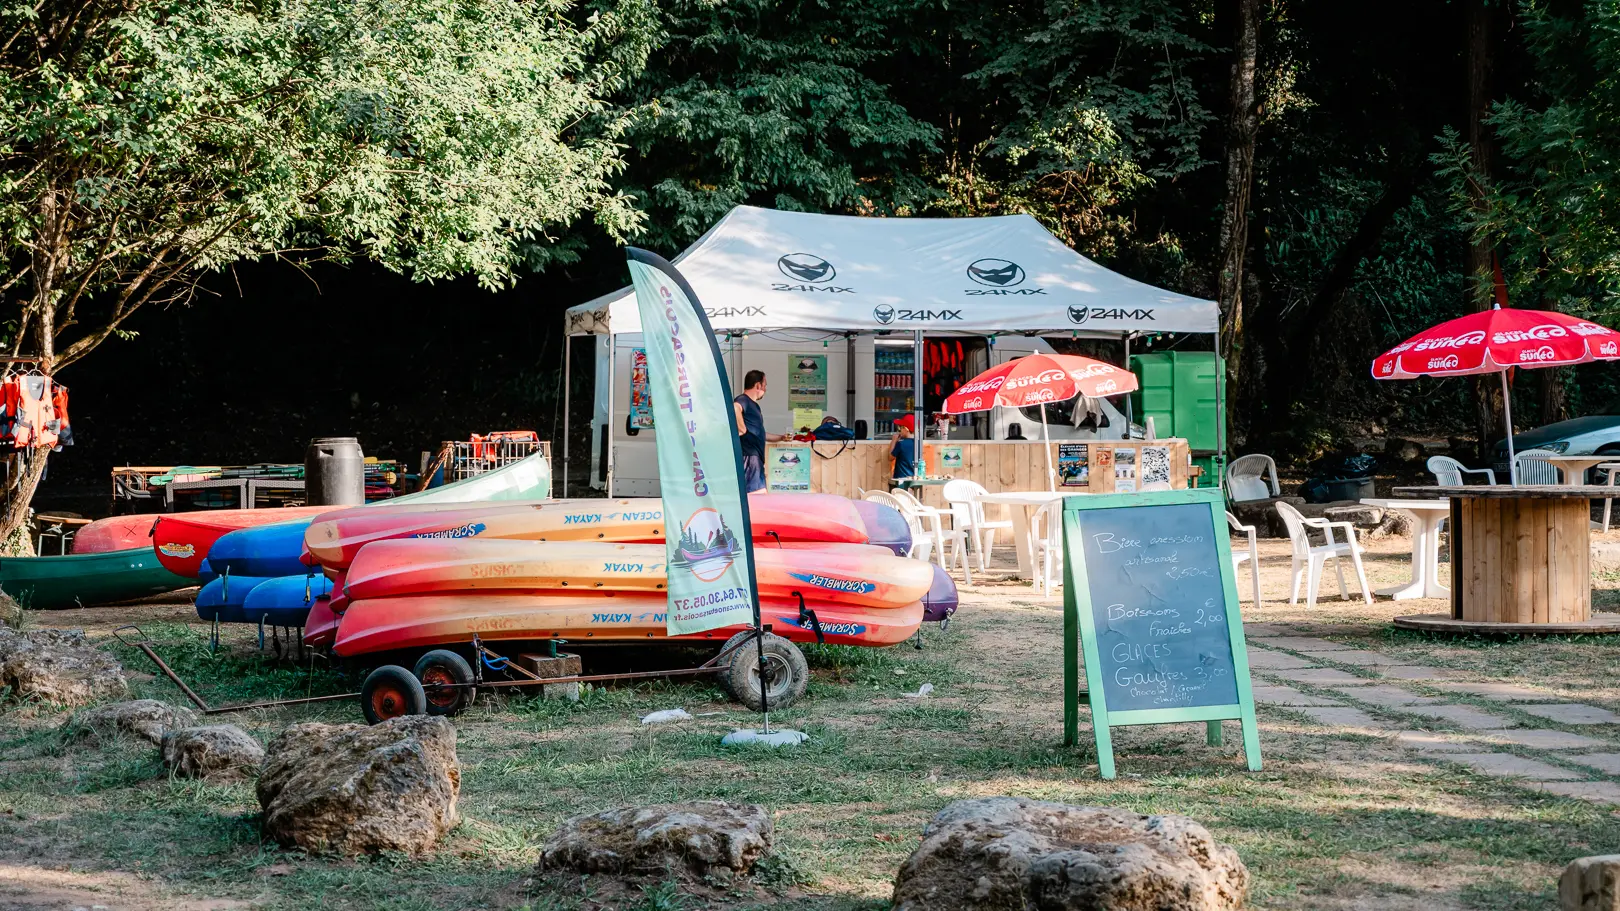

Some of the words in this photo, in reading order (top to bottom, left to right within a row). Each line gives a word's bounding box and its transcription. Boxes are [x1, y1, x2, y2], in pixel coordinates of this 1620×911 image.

[771, 283, 856, 294] 24MX
[964, 288, 1048, 296] 24MX
[704, 305, 768, 318] 24MX
[897, 309, 964, 321] 24MX
[1090, 307, 1156, 321] 24MX
[563, 513, 602, 525] KAYAK
[622, 511, 662, 521] OCEAN
[602, 562, 644, 573] KAYAK
[809, 573, 868, 594] SCRAMBLER
[590, 613, 632, 623] KAYAK
[1106, 603, 1181, 621] Boissons
[1194, 608, 1223, 628] 2,00
[1112, 642, 1172, 664] GLACES
[1115, 662, 1188, 688] Gaufres
